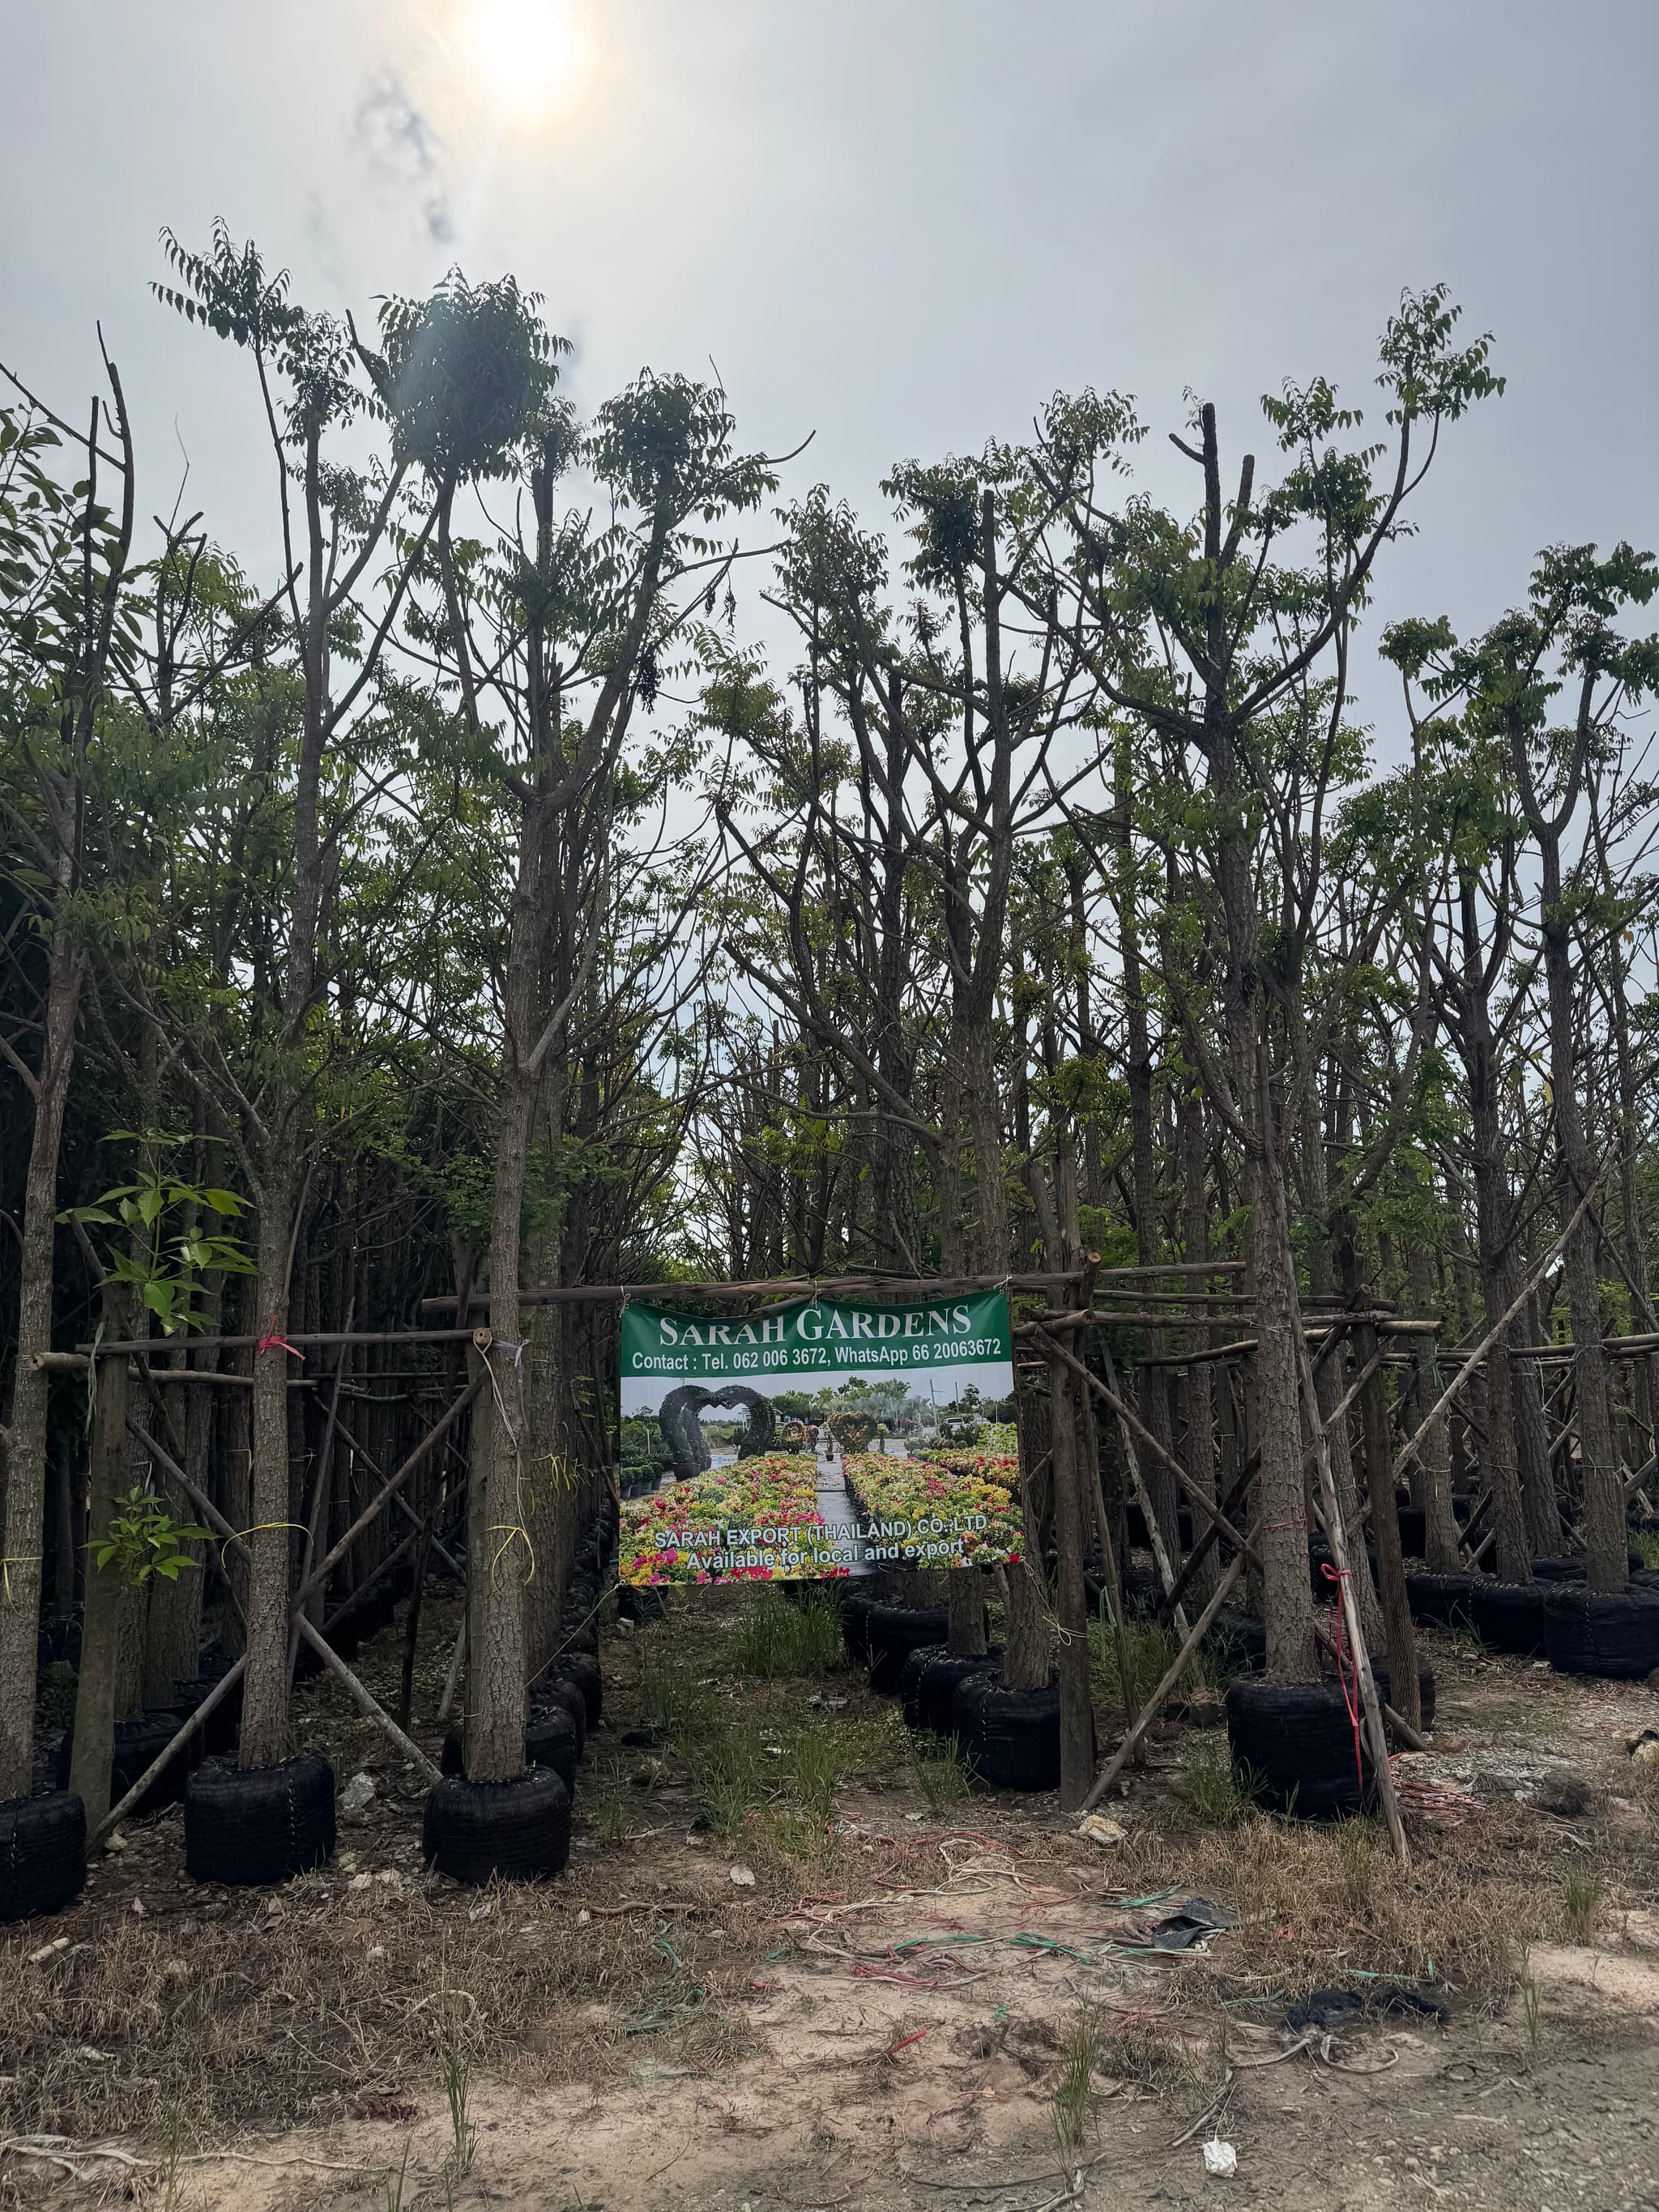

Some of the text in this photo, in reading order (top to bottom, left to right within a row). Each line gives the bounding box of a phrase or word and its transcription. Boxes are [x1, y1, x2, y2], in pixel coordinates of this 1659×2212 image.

[660, 1303, 971, 1346] SARAH GARDENS
[632, 1351, 689, 1370] Contact
[702, 1353, 728, 1370] Tel.
[732, 1352, 759, 1369] 062
[762, 1350, 788, 1366] 006
[792, 1347, 831, 1366] 3672,
[834, 1346, 908, 1366] WhatsApp
[912, 1345, 930, 1362] 66
[933, 1338, 1001, 1360] 20063672
[654, 1529, 720, 1549] SARAH
[727, 1526, 802, 1545] EXPORT
[807, 1519, 912, 1545] (THAILAND)
[686, 1538, 964, 1570] Available for local and export
